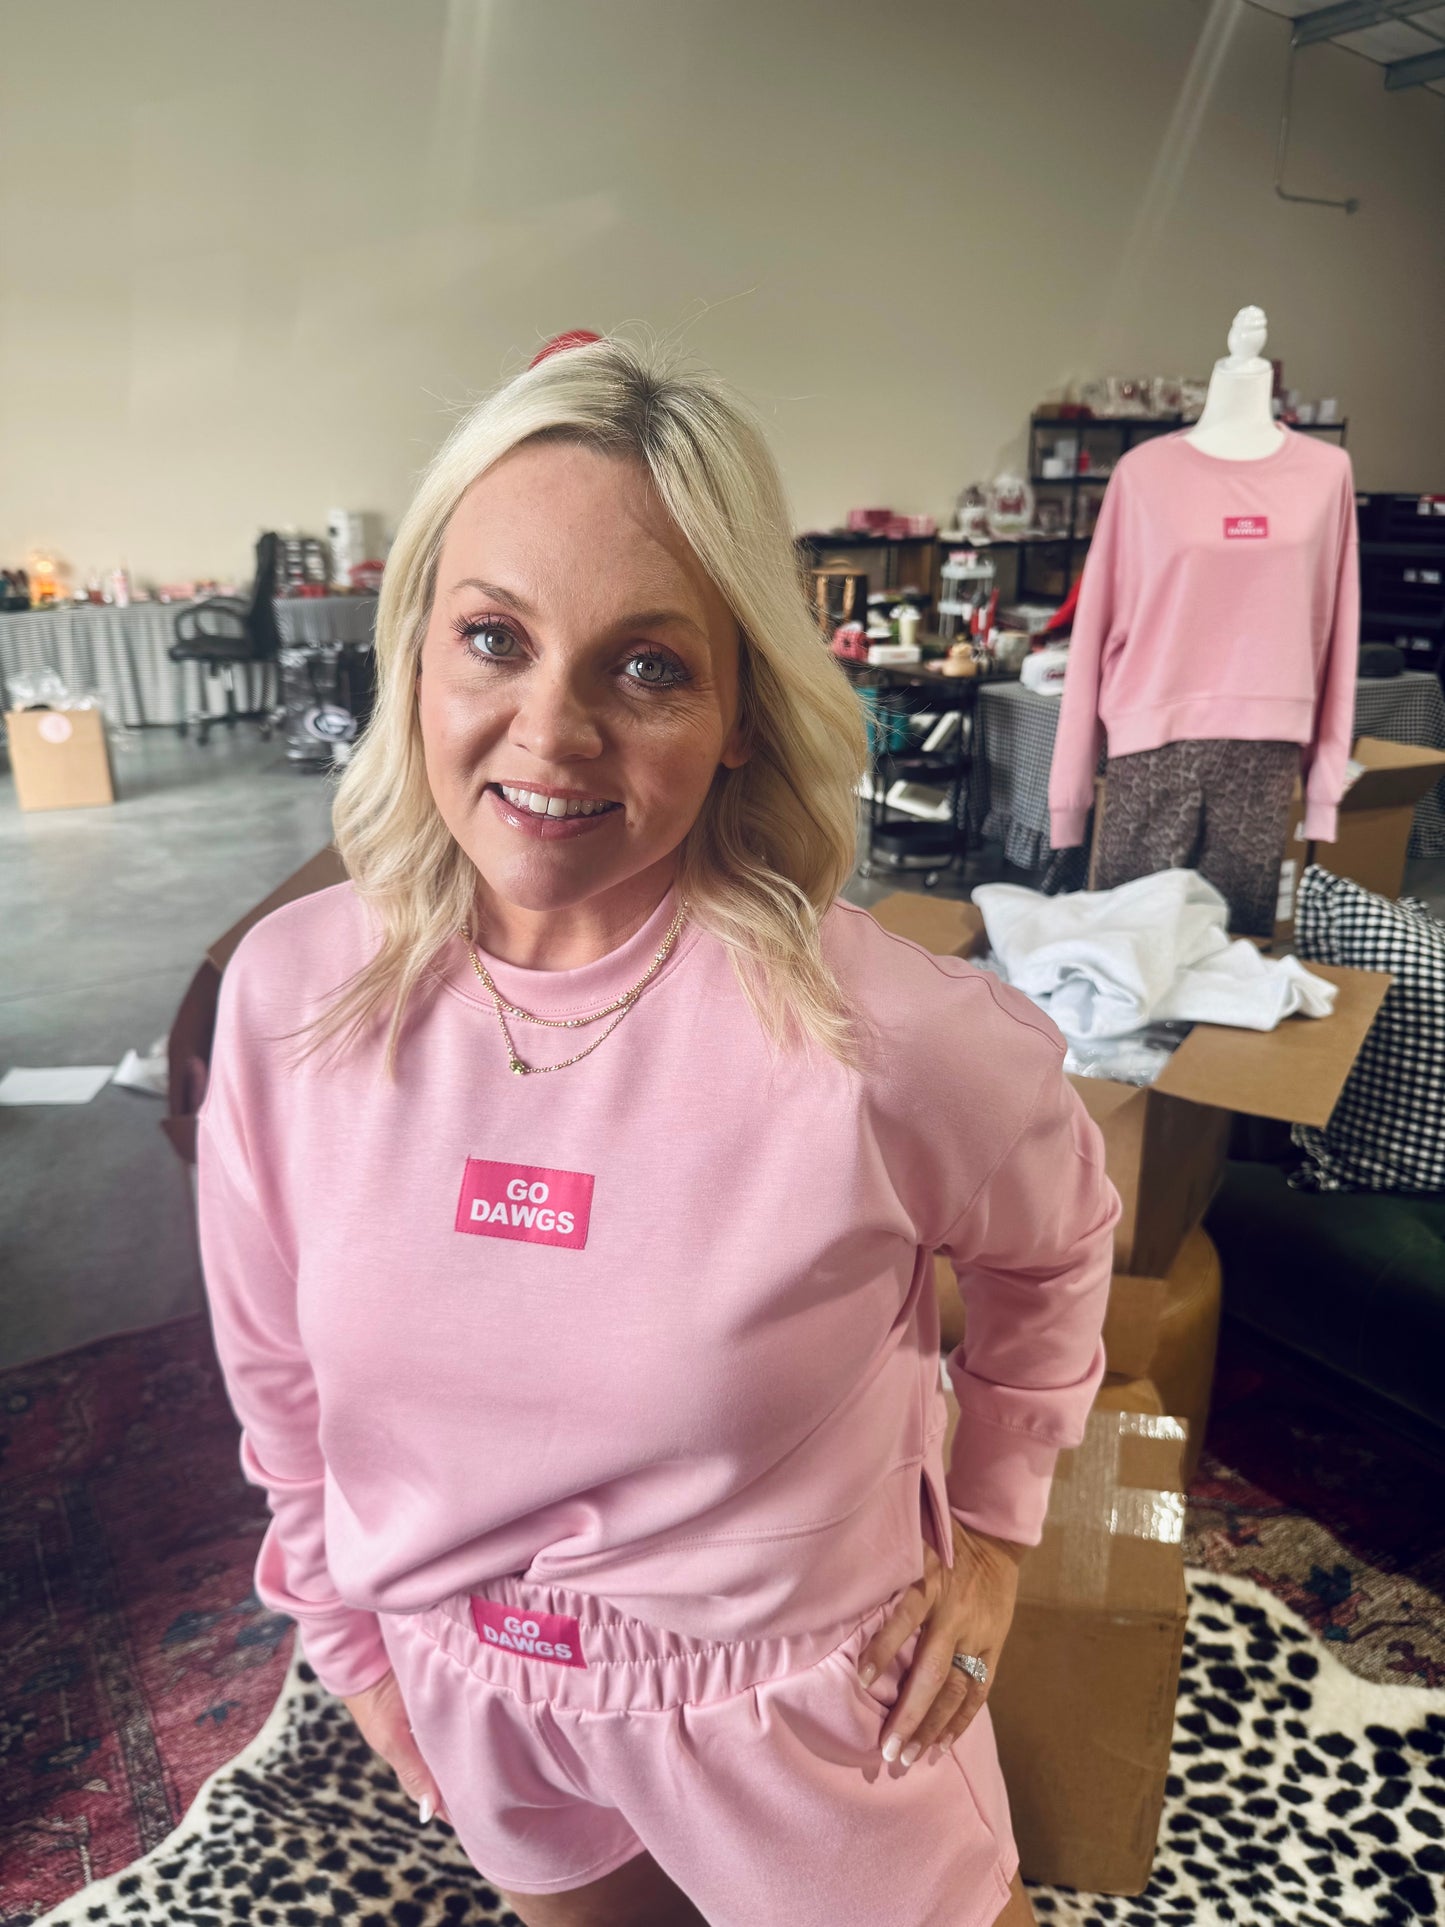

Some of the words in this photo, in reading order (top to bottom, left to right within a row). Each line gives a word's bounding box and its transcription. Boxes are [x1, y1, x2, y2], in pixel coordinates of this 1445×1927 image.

[506, 1178, 549, 1204] GO
[470, 1198, 575, 1234] DAWGS
[483, 1623, 573, 1659] DAWGS
[503, 1616, 540, 1638] GO
